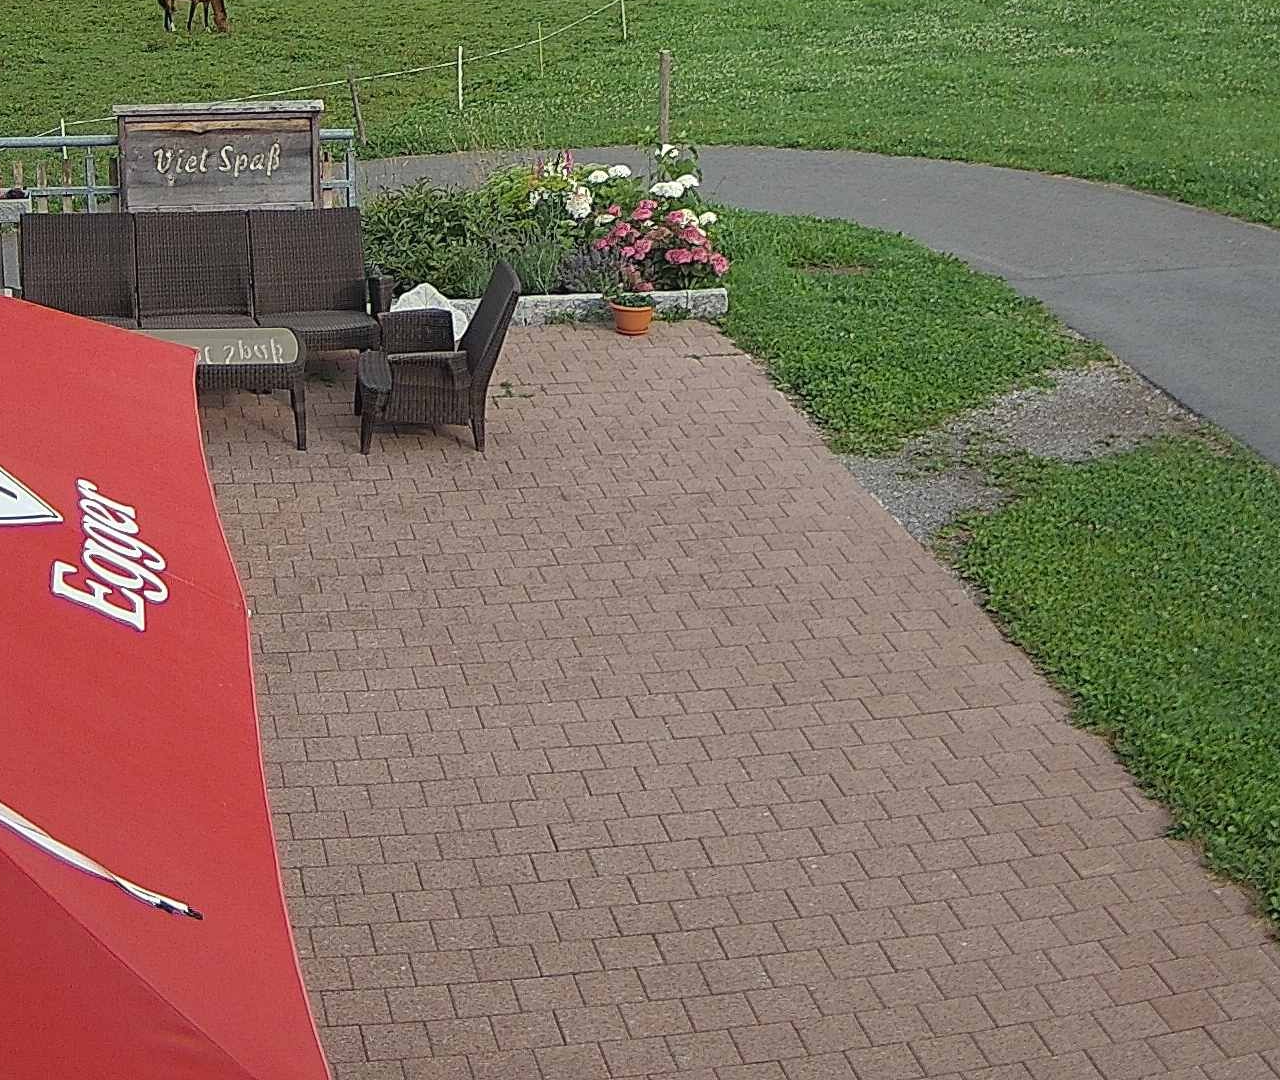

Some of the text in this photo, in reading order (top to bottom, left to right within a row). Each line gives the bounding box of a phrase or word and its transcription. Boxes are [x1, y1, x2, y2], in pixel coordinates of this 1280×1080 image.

[153, 143, 281, 177] Viel Spaß
[51, 477, 170, 632] Egger
